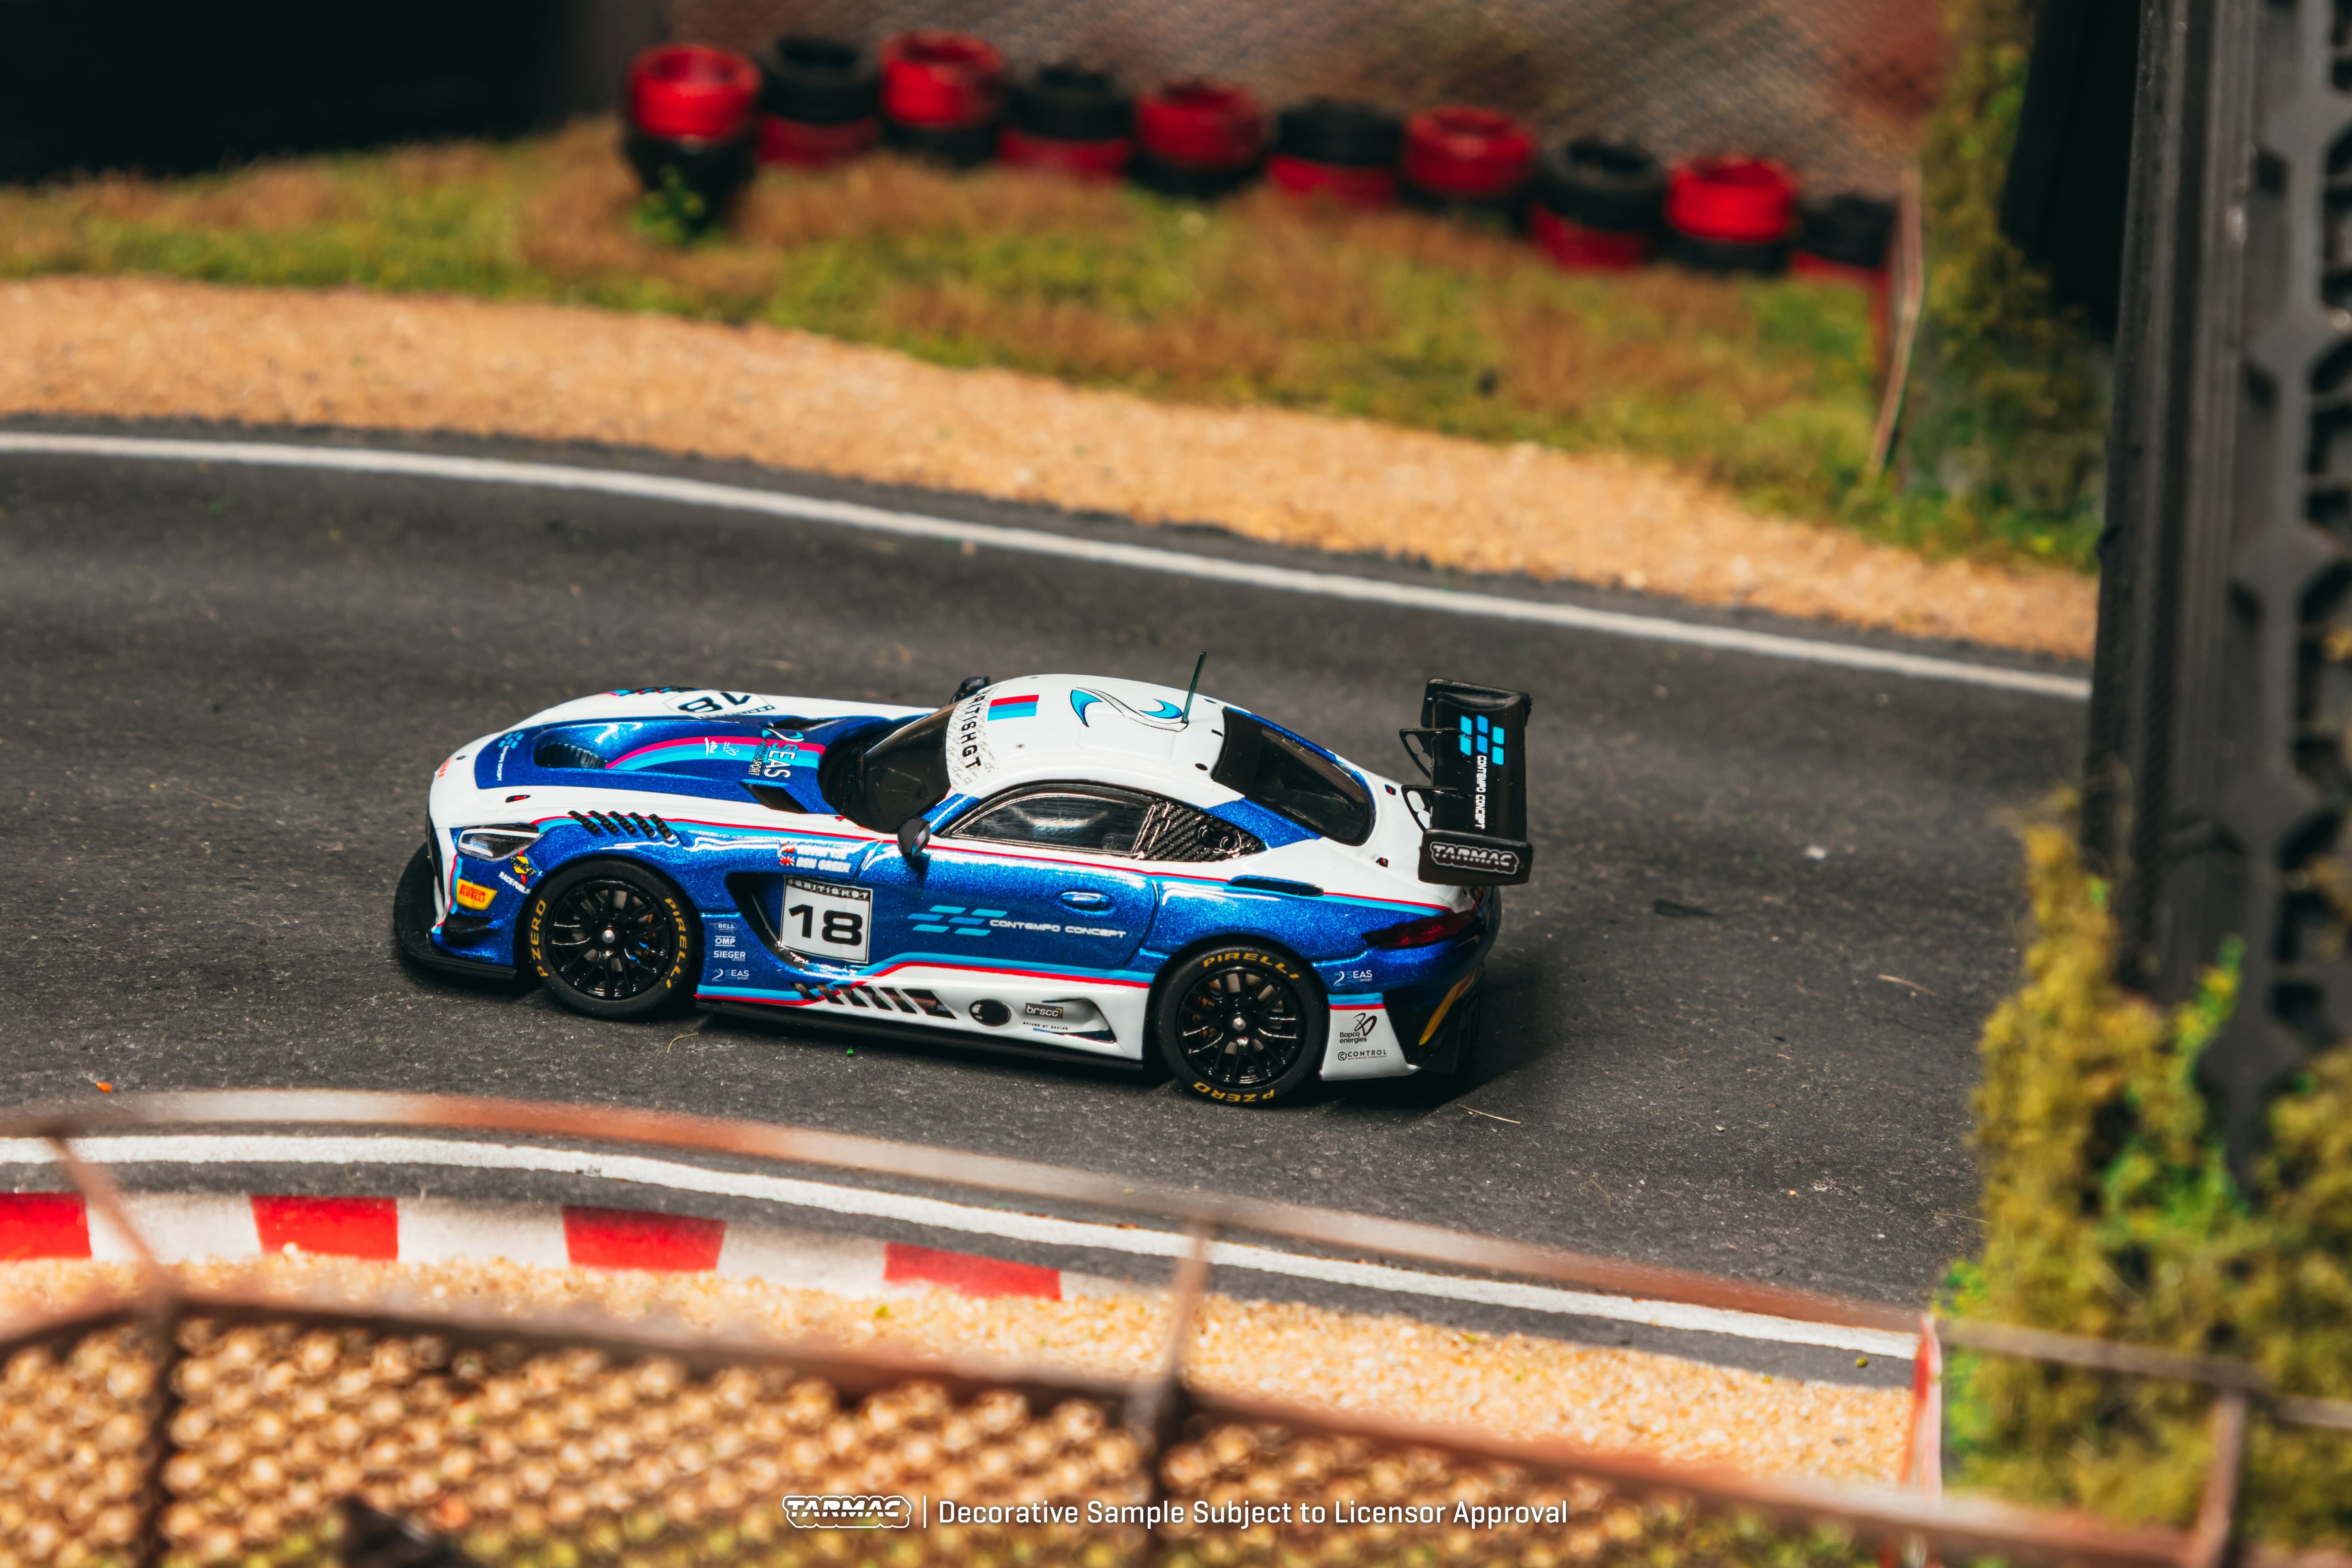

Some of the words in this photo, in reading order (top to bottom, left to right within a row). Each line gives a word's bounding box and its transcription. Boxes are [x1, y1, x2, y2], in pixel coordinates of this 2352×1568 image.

[678, 691, 752, 713] 18
[763, 742, 799, 778] SEAS
[1476, 755, 1487, 793] CONTEMPO
[1475, 794, 1486, 830] CONCEPT
[1433, 844, 1513, 866] TARMAC
[459, 883, 486, 903] PIRELLI
[530, 899, 546, 961] ZERO
[788, 904, 863, 946] 18
[989, 919, 1061, 932] CONTEMPO
[1064, 925, 1127, 939] CONCEPT
[664, 898, 687, 989] PIRELLI
[713, 950, 746, 959] SIEGER
[536, 965, 549, 977] P
[1203, 952, 1300, 979] PIRELLI
[1346, 970, 1373, 979] SEAS
[1026, 1005, 1059, 1017] brscc
[1193, 1082, 1257, 1102] ZERO
[1262, 1089, 1274, 1099] P
